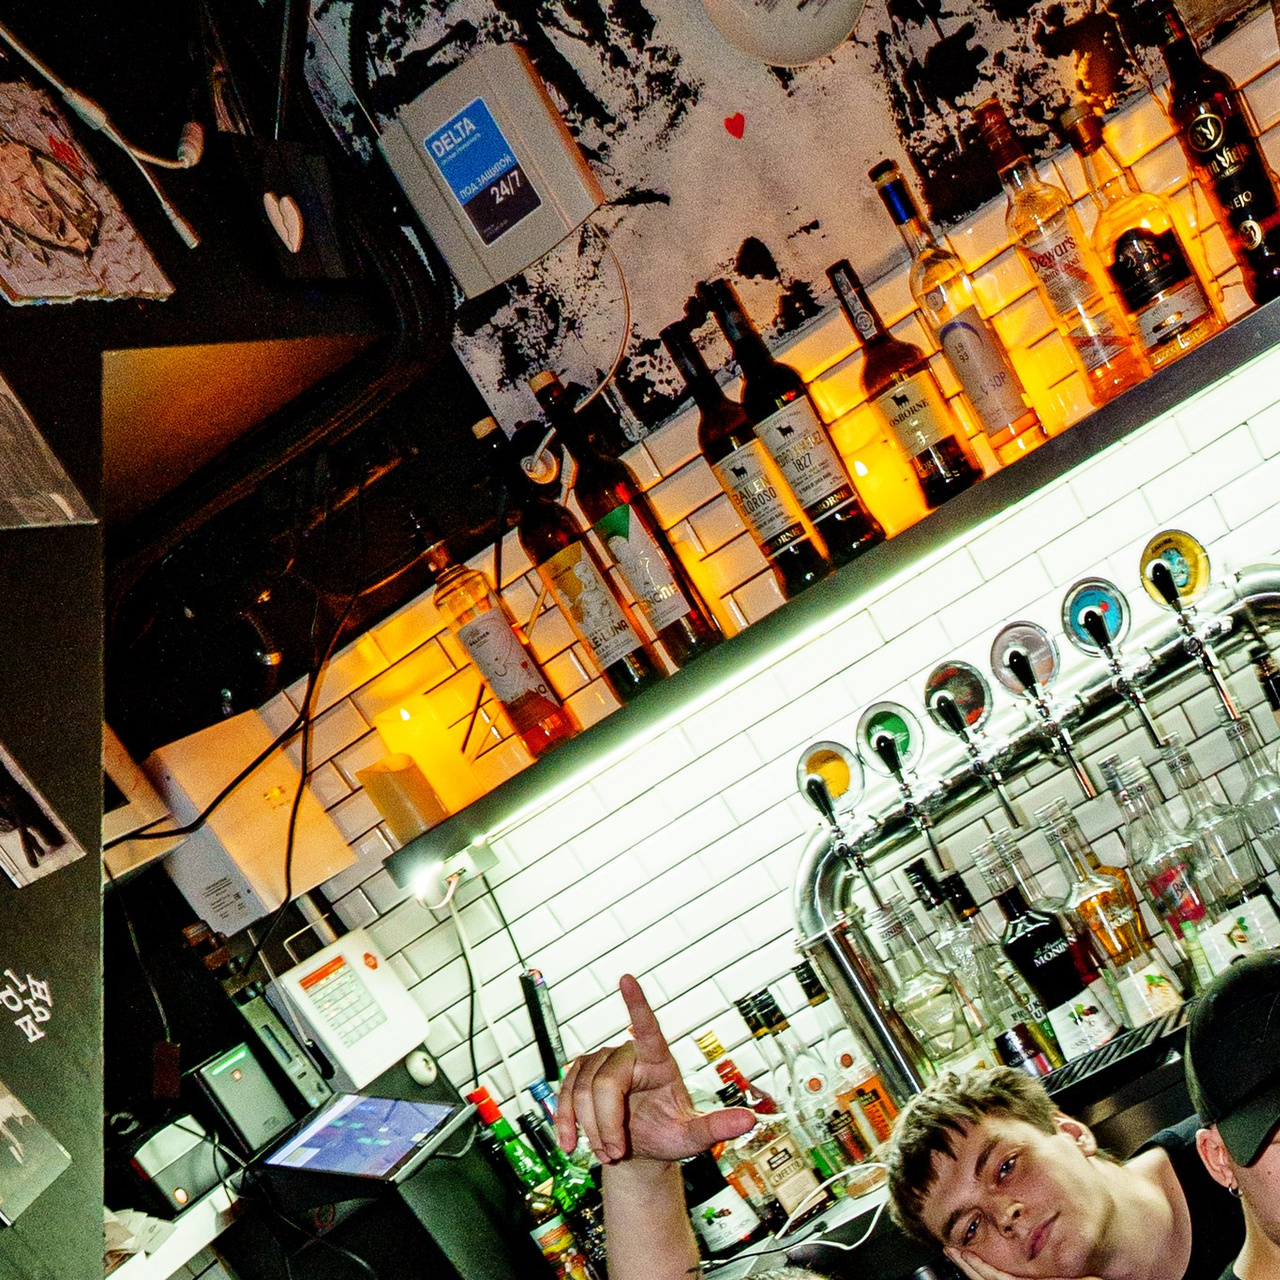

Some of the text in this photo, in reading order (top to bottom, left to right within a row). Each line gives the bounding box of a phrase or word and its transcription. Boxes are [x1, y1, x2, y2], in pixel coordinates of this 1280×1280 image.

[429, 115, 477, 158] DELTA
[458, 151, 513, 200] ПОД ЗАЩИТОЙ
[487, 169, 523, 205] 24/7
[1027, 232, 1077, 273] Dewar's
[952, 341, 965, 354] 19
[957, 350, 970, 363] 93
[887, 396, 930, 428] OSBORNE
[791, 451, 814, 473] 1827
